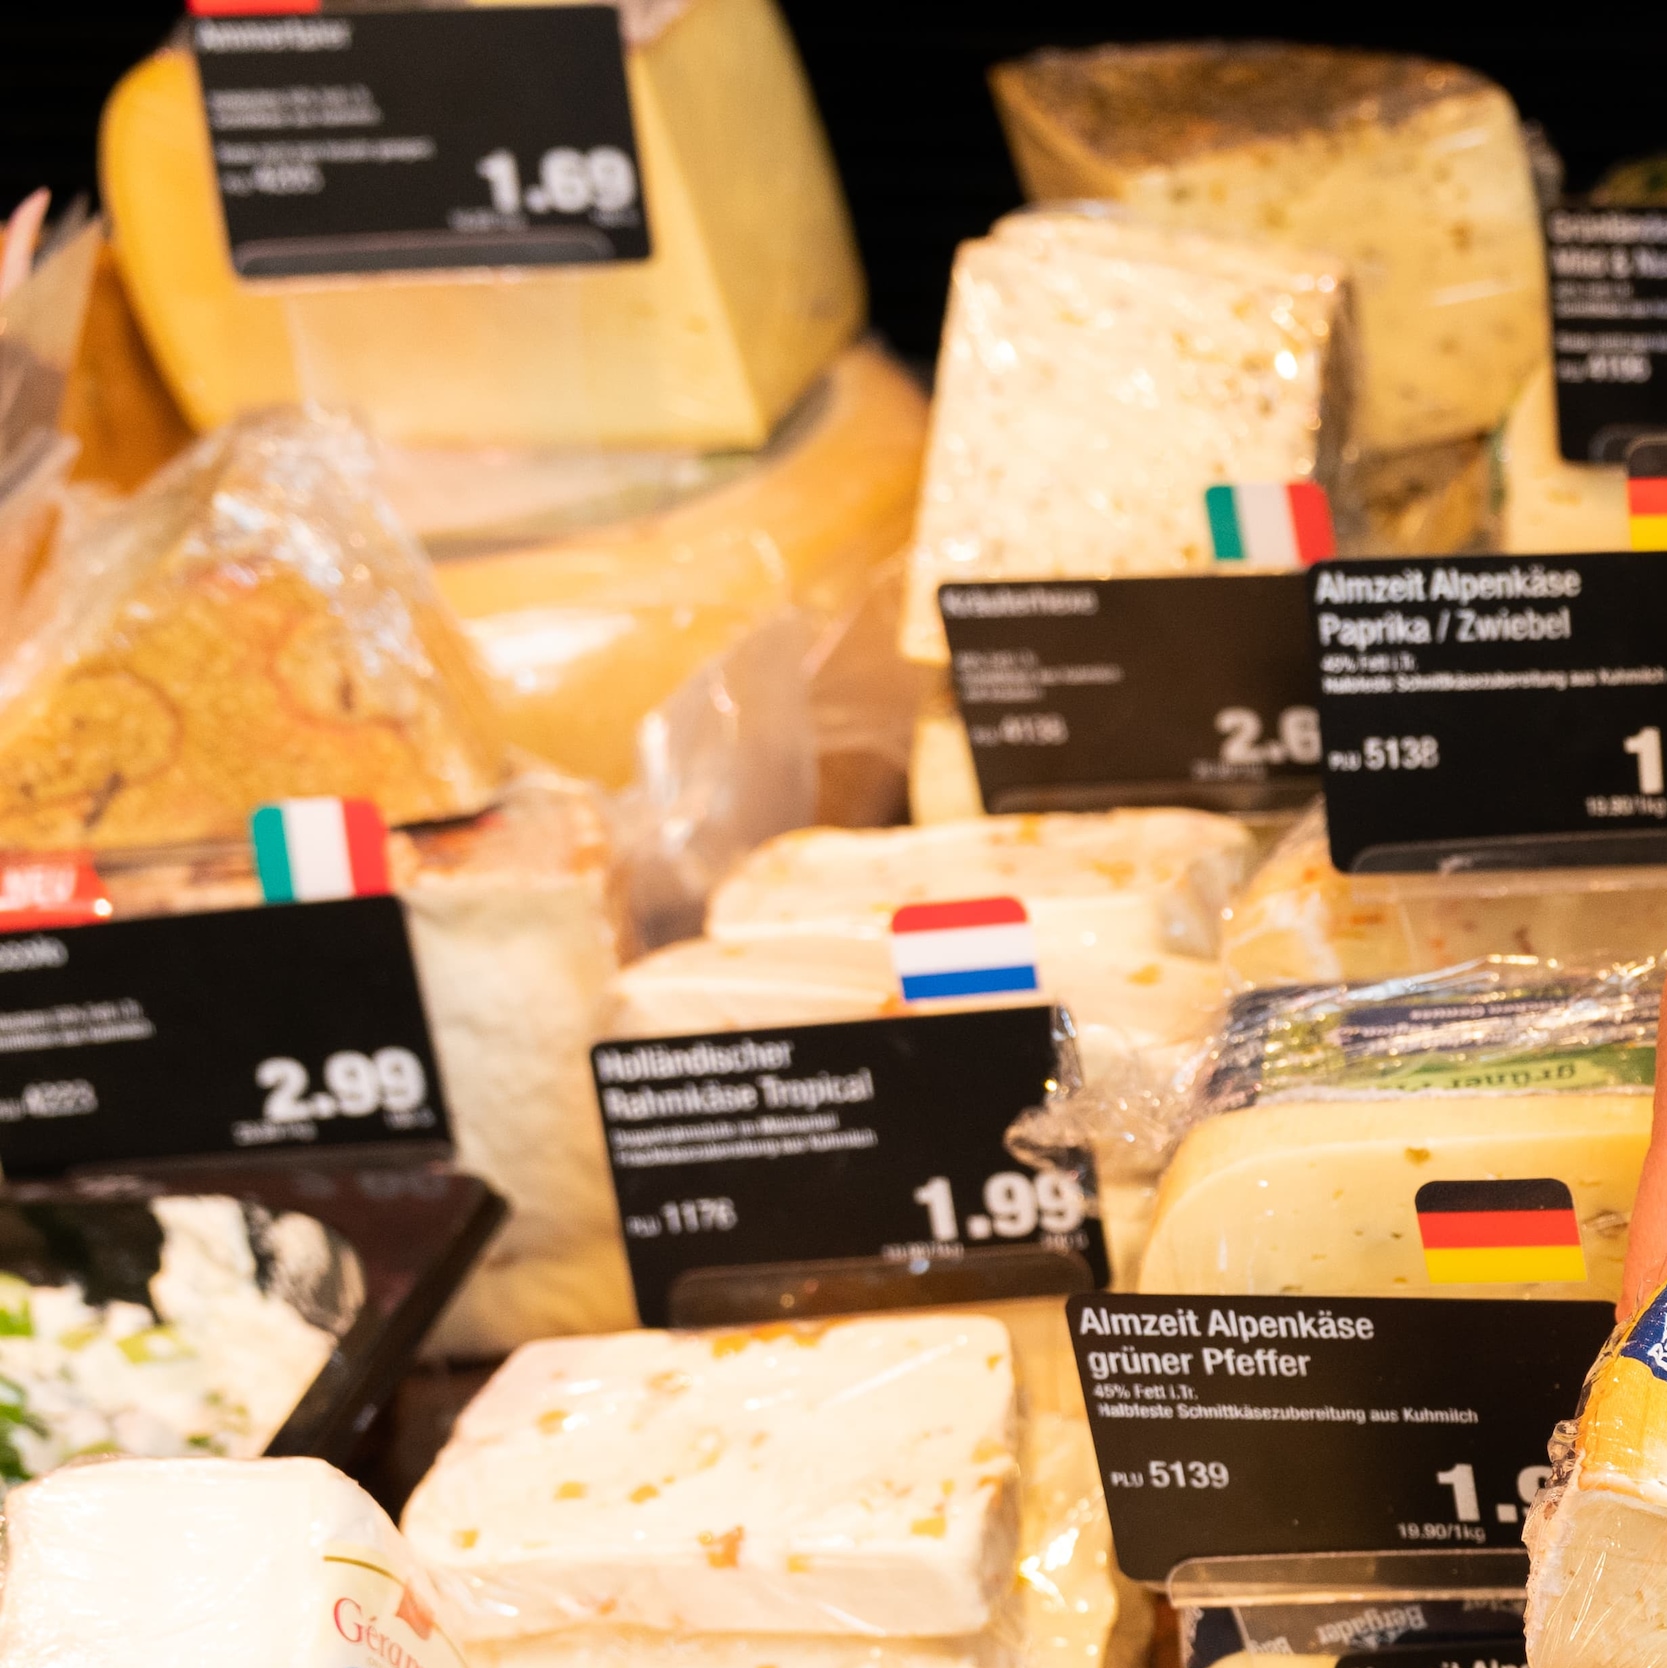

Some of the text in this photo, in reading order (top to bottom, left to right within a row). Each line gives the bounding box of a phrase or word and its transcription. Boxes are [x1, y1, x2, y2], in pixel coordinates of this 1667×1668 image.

[255, 1047, 427, 1122] 2.99
[1080, 1308, 1373, 1343] Almzeit Alpenkäse
[1088, 1346, 1310, 1379] grüner Pfeffer
[1150, 1461, 1229, 1488] 5139
